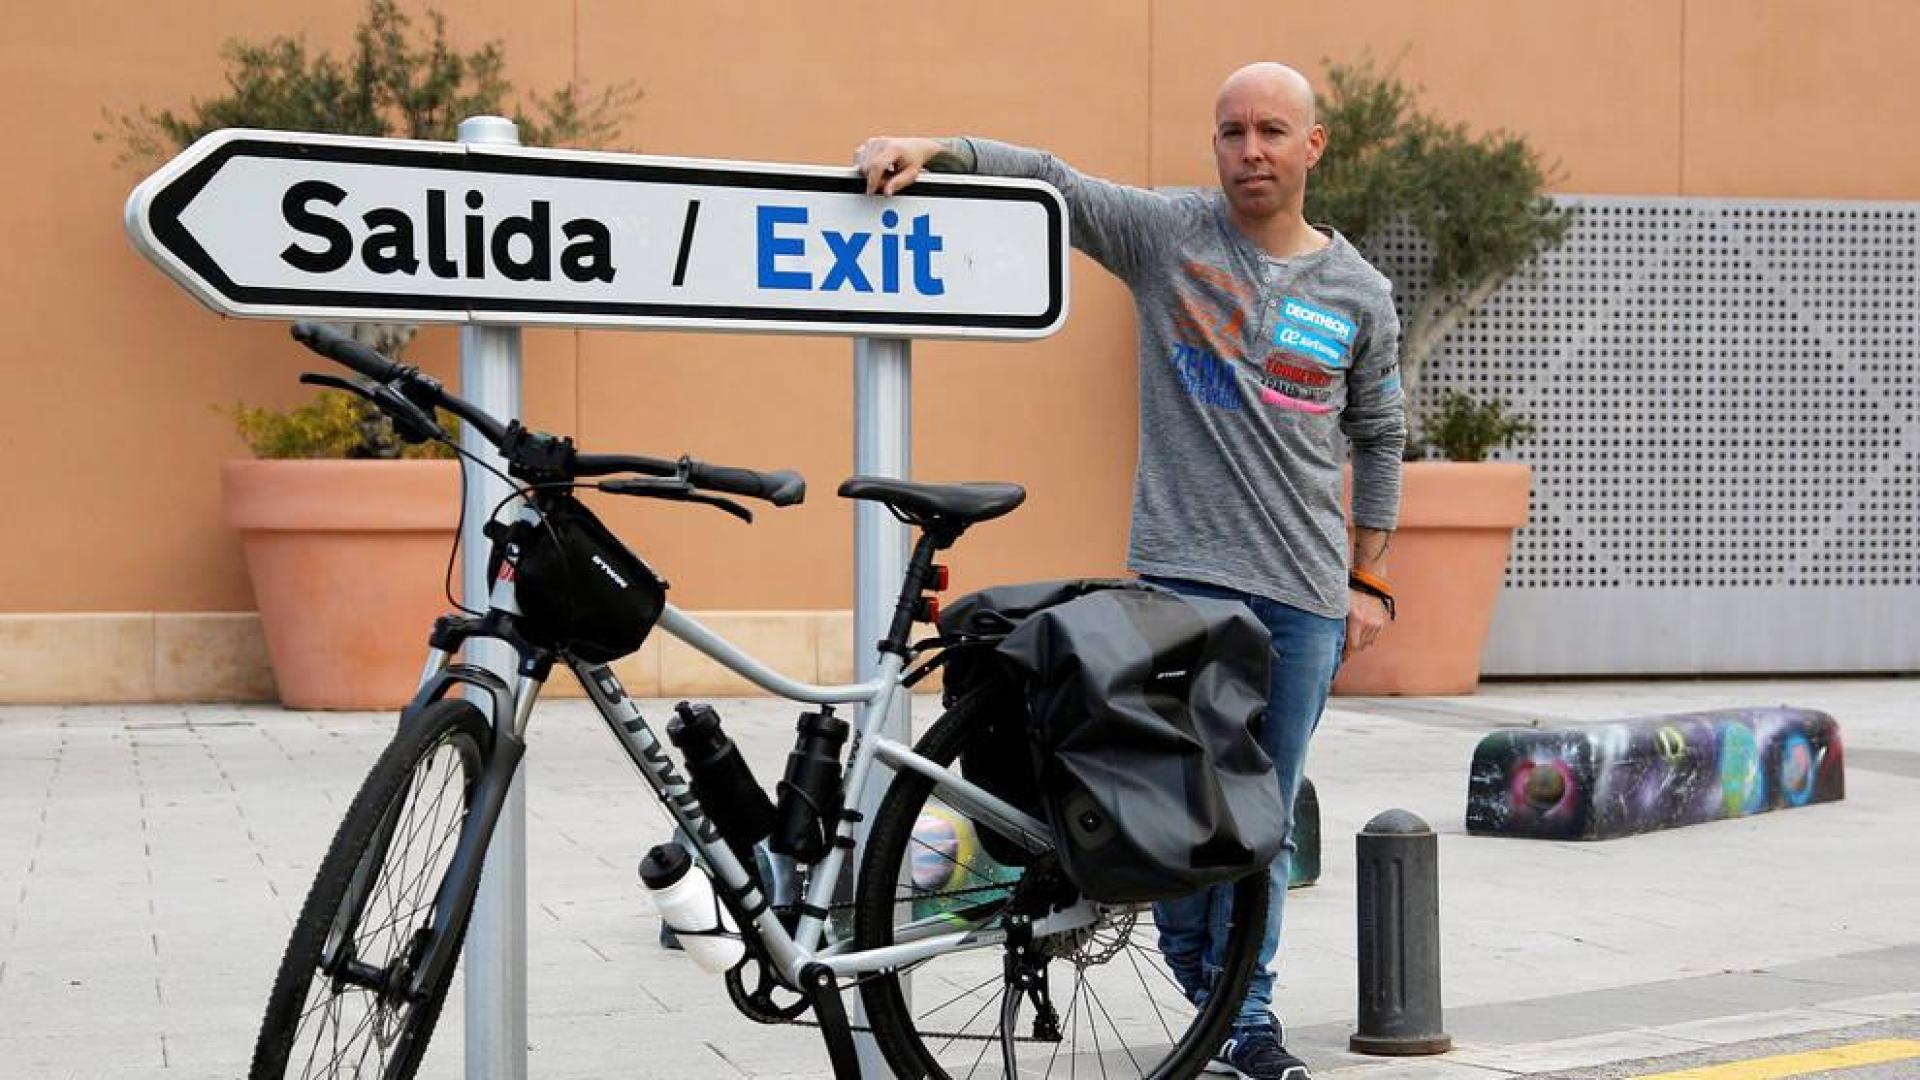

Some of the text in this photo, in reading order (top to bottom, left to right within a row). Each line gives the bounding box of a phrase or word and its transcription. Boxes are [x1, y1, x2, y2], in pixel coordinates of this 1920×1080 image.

[281, 179, 945, 296] Salida / Exit
[1285, 302, 1350, 338] DECATHLON
